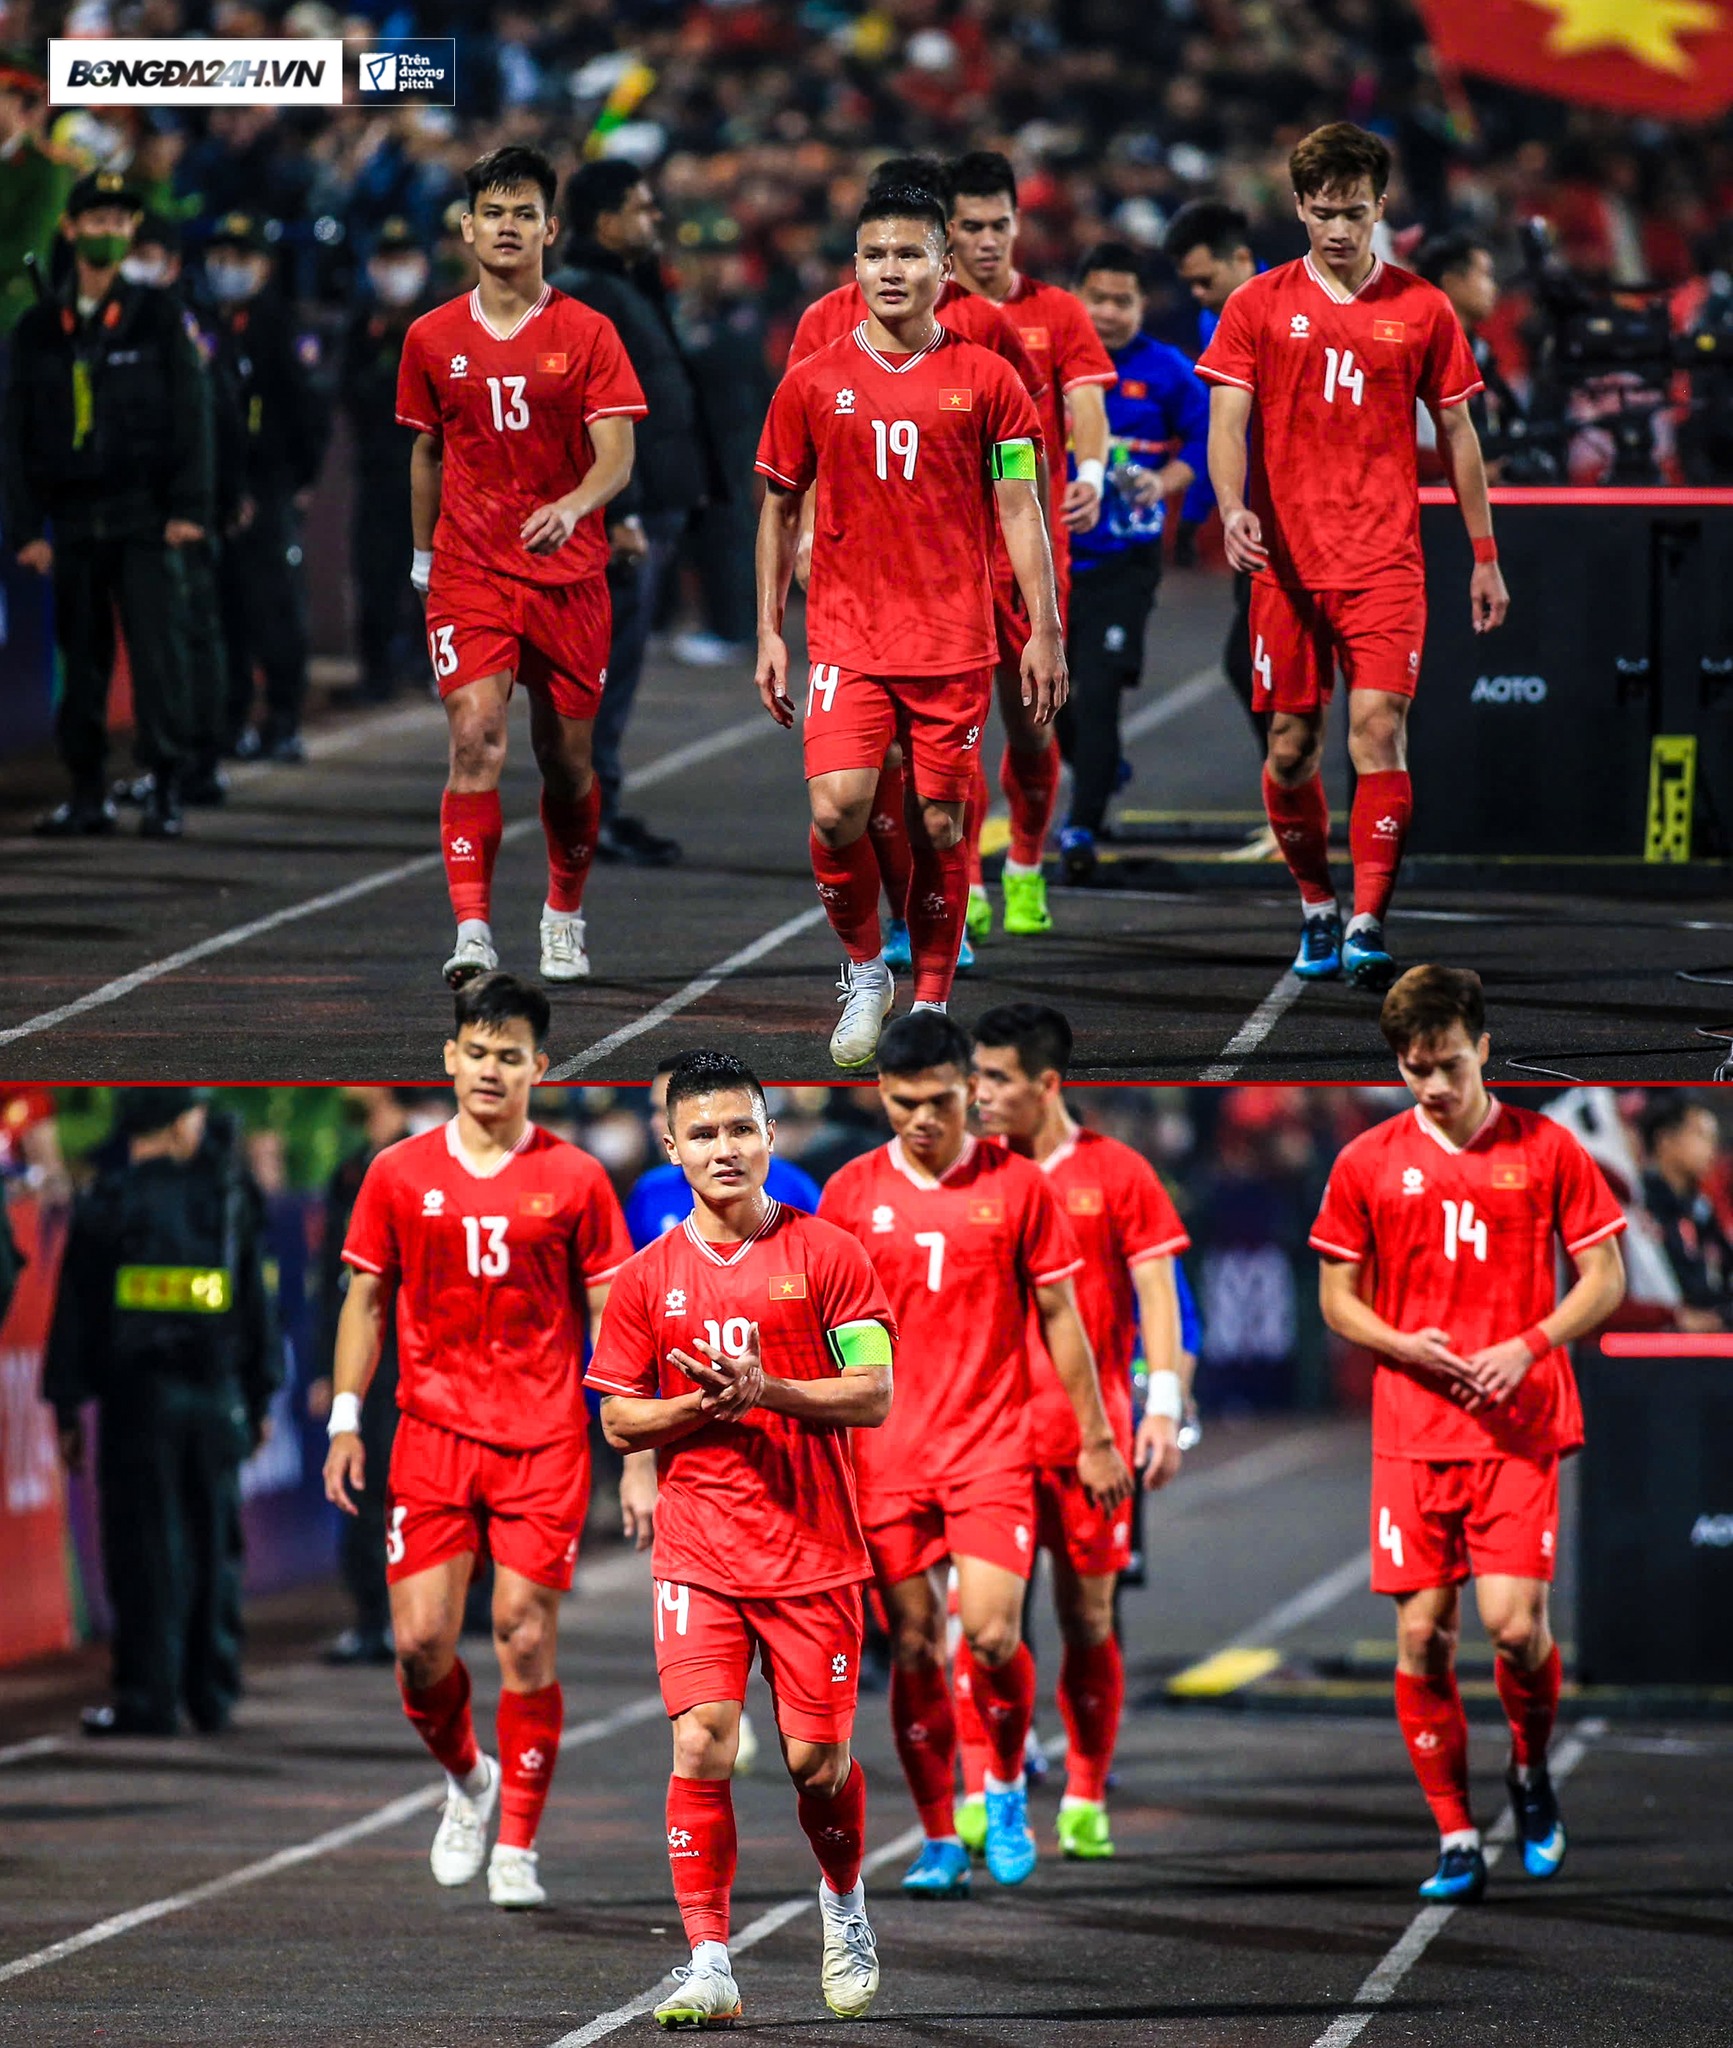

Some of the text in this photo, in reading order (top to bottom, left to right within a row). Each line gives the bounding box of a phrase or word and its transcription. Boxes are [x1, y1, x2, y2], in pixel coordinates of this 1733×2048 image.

[486, 375, 530, 431] 13
[1323, 347, 1364, 406] 14
[871, 419, 919, 480] 19
[1471, 675, 1547, 703] AOTO
[461, 1215, 510, 1278] 13
[1441, 1199, 1488, 1263] 14
[914, 1231, 945, 1293] 7
